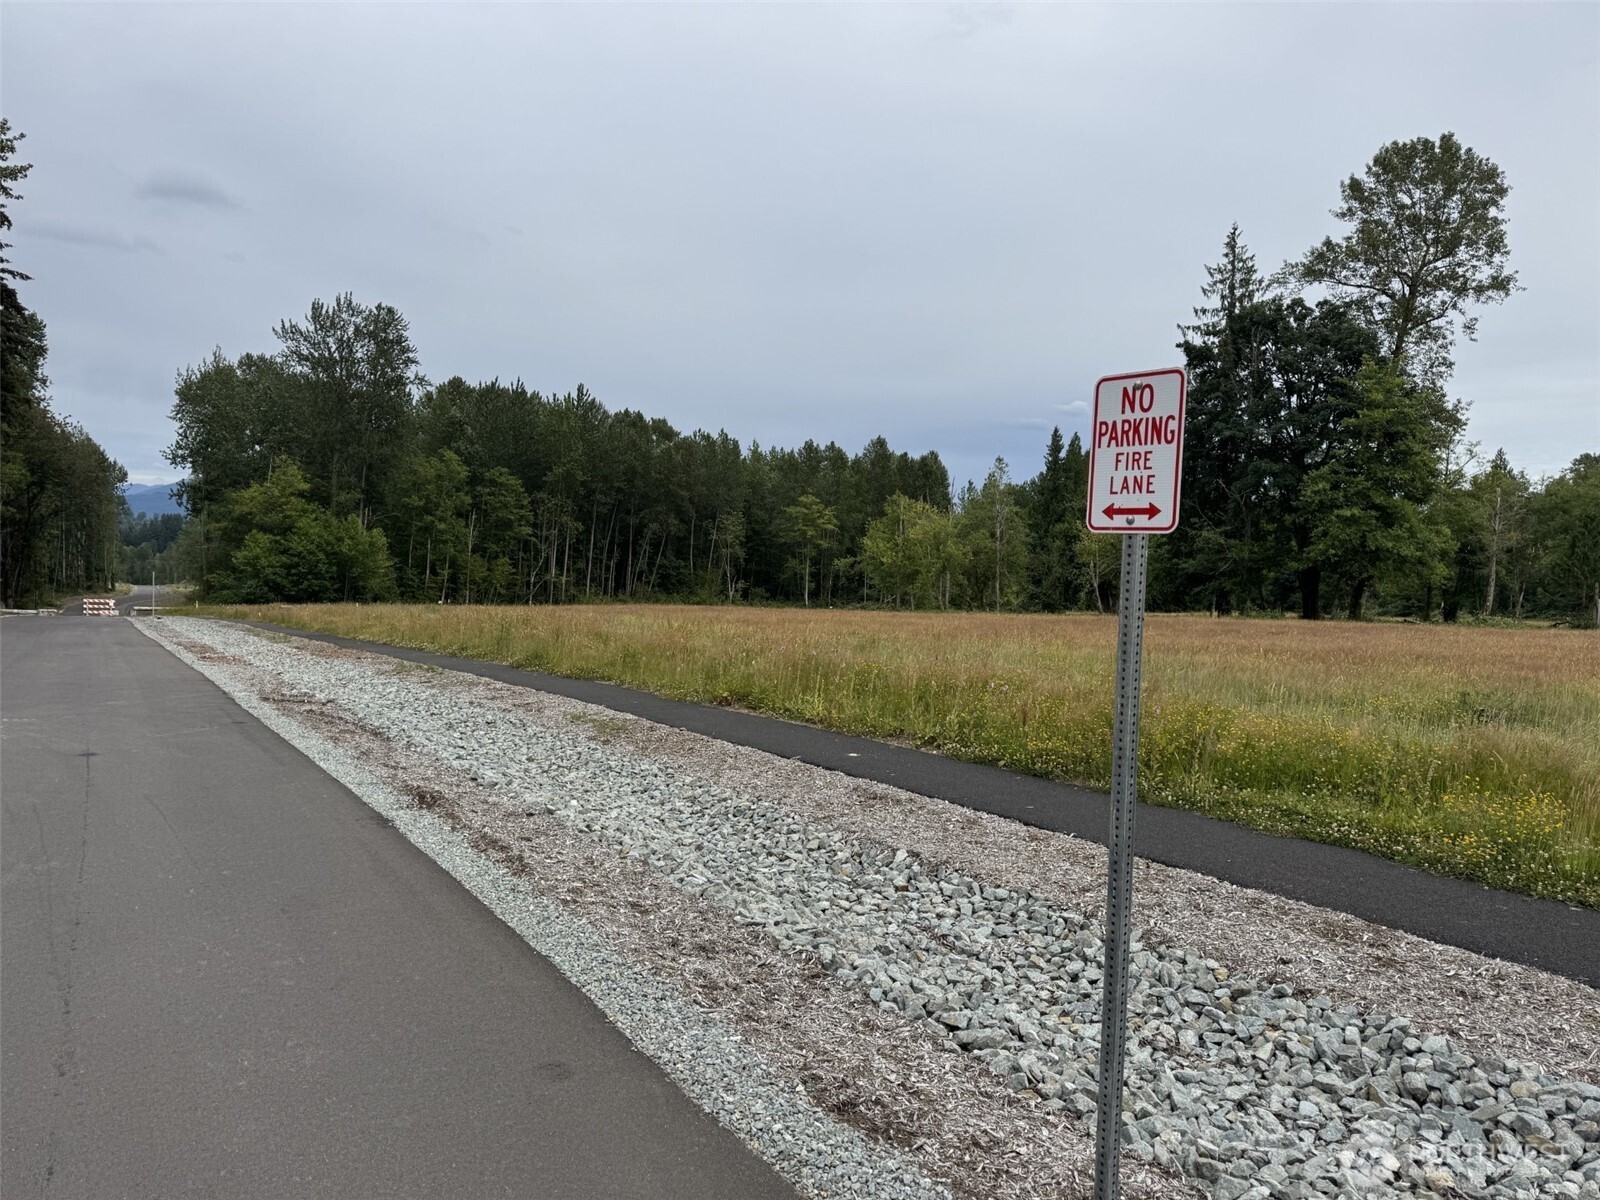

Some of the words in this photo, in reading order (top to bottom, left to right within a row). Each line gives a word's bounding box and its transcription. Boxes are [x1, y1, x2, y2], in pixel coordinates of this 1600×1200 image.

[1121, 383, 1154, 414] NO
[1097, 414, 1176, 449] PARKING
[1115, 450, 1153, 471] FIRE
[1109, 474, 1156, 495] LANE
